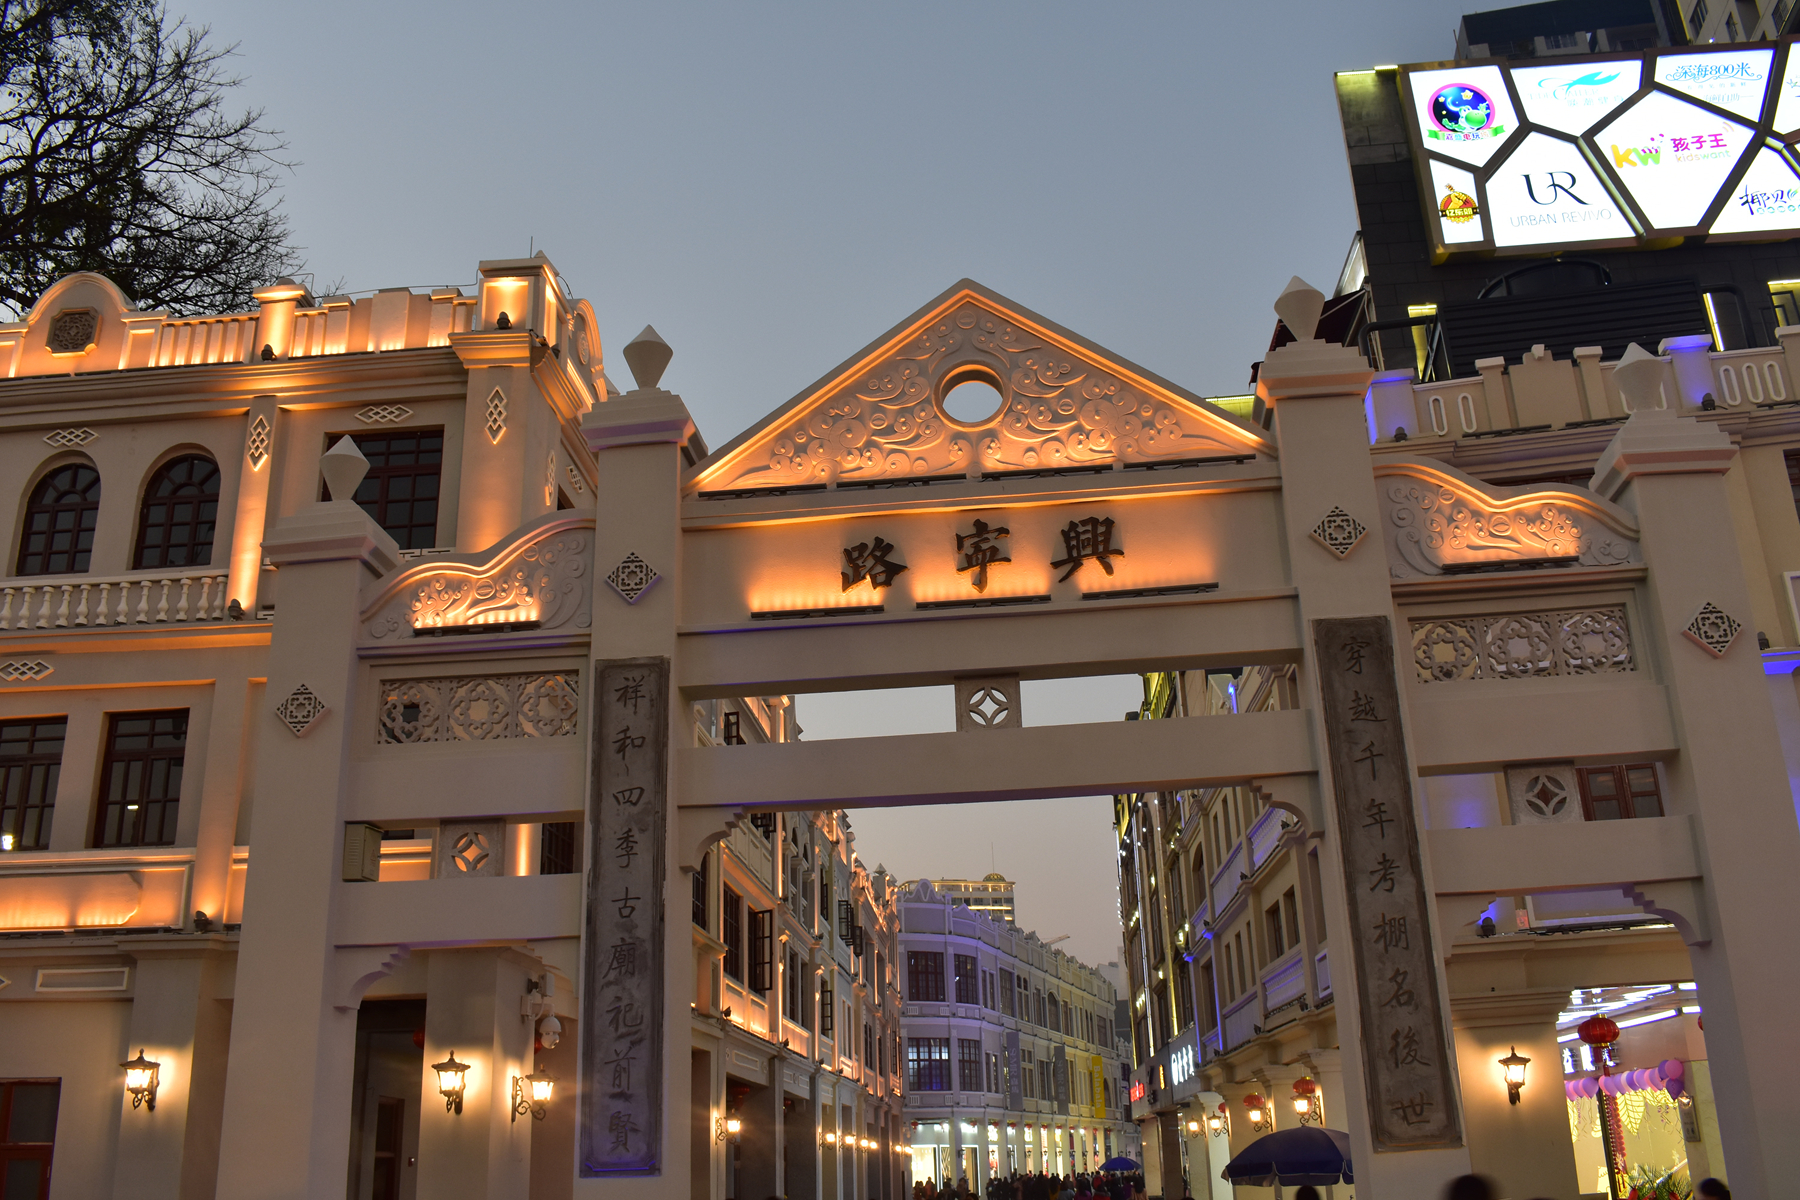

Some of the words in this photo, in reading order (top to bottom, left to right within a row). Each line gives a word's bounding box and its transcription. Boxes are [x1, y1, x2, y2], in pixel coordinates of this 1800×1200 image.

[1676, 62, 1754, 79] 深海800米
[1670, 133, 1728, 153] 孩子王
[1675, 150, 1732, 163] kidswant
[1520, 171, 1593, 206] UR
[1509, 213, 1557, 228] URBAN
[1561, 208, 1612, 223] REVIVO
[1093, 1065, 1103, 1108] Balabala
